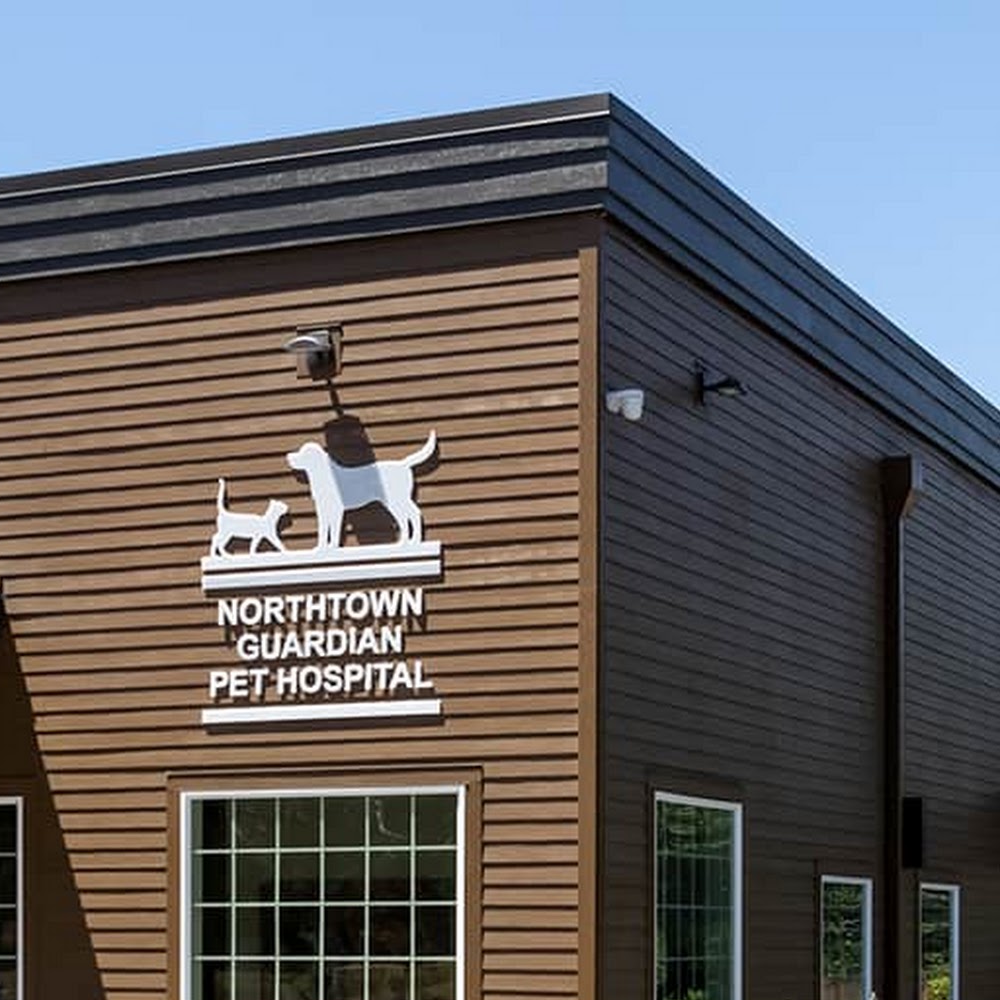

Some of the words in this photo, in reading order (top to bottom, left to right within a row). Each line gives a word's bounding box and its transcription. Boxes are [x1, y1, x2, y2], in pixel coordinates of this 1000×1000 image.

[218, 588, 423, 626] NORTHTOWN
[237, 625, 402, 660] GUARDIAN
[209, 668, 268, 698] PET
[277, 660, 433, 694] HOSPITAL
